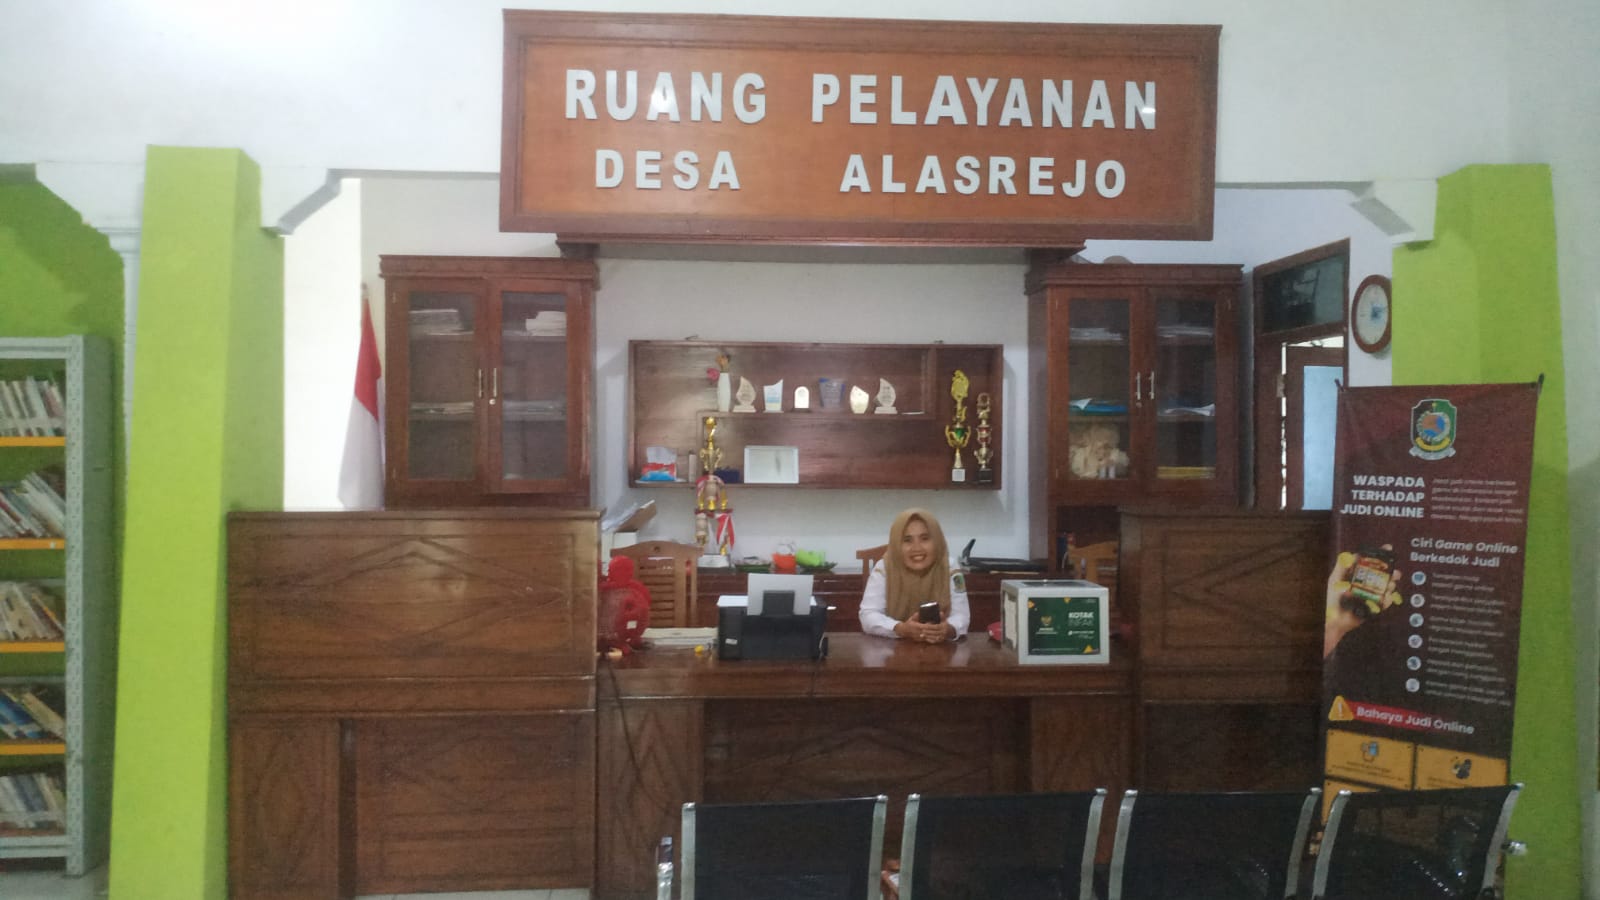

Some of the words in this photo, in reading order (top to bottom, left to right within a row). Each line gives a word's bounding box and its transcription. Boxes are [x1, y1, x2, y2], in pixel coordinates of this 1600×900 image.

[565, 69, 767, 124] RUANG
[811, 73, 1156, 131] PELAYANAN
[594, 148, 741, 191] DESA
[840, 153, 1127, 199] ALASREJO
[1353, 475, 1425, 488] WASPADA
[1351, 489, 1425, 503] TERHADAP
[1340, 504, 1371, 516] JUDI
[1373, 505, 1425, 518] ONLINE
[1410, 537, 1433, 548] Ciri
[1435, 539, 1473, 551] Game
[1475, 541, 1518, 554] Online
[1410, 551, 1469, 565] Berkedok
[1471, 556, 1500, 568] Judi
[1068, 611, 1094, 619] KOTAK
[1356, 706, 1403, 724] Bahaya
[1405, 715, 1432, 728] Judi
[1433, 719, 1475, 735] Online
